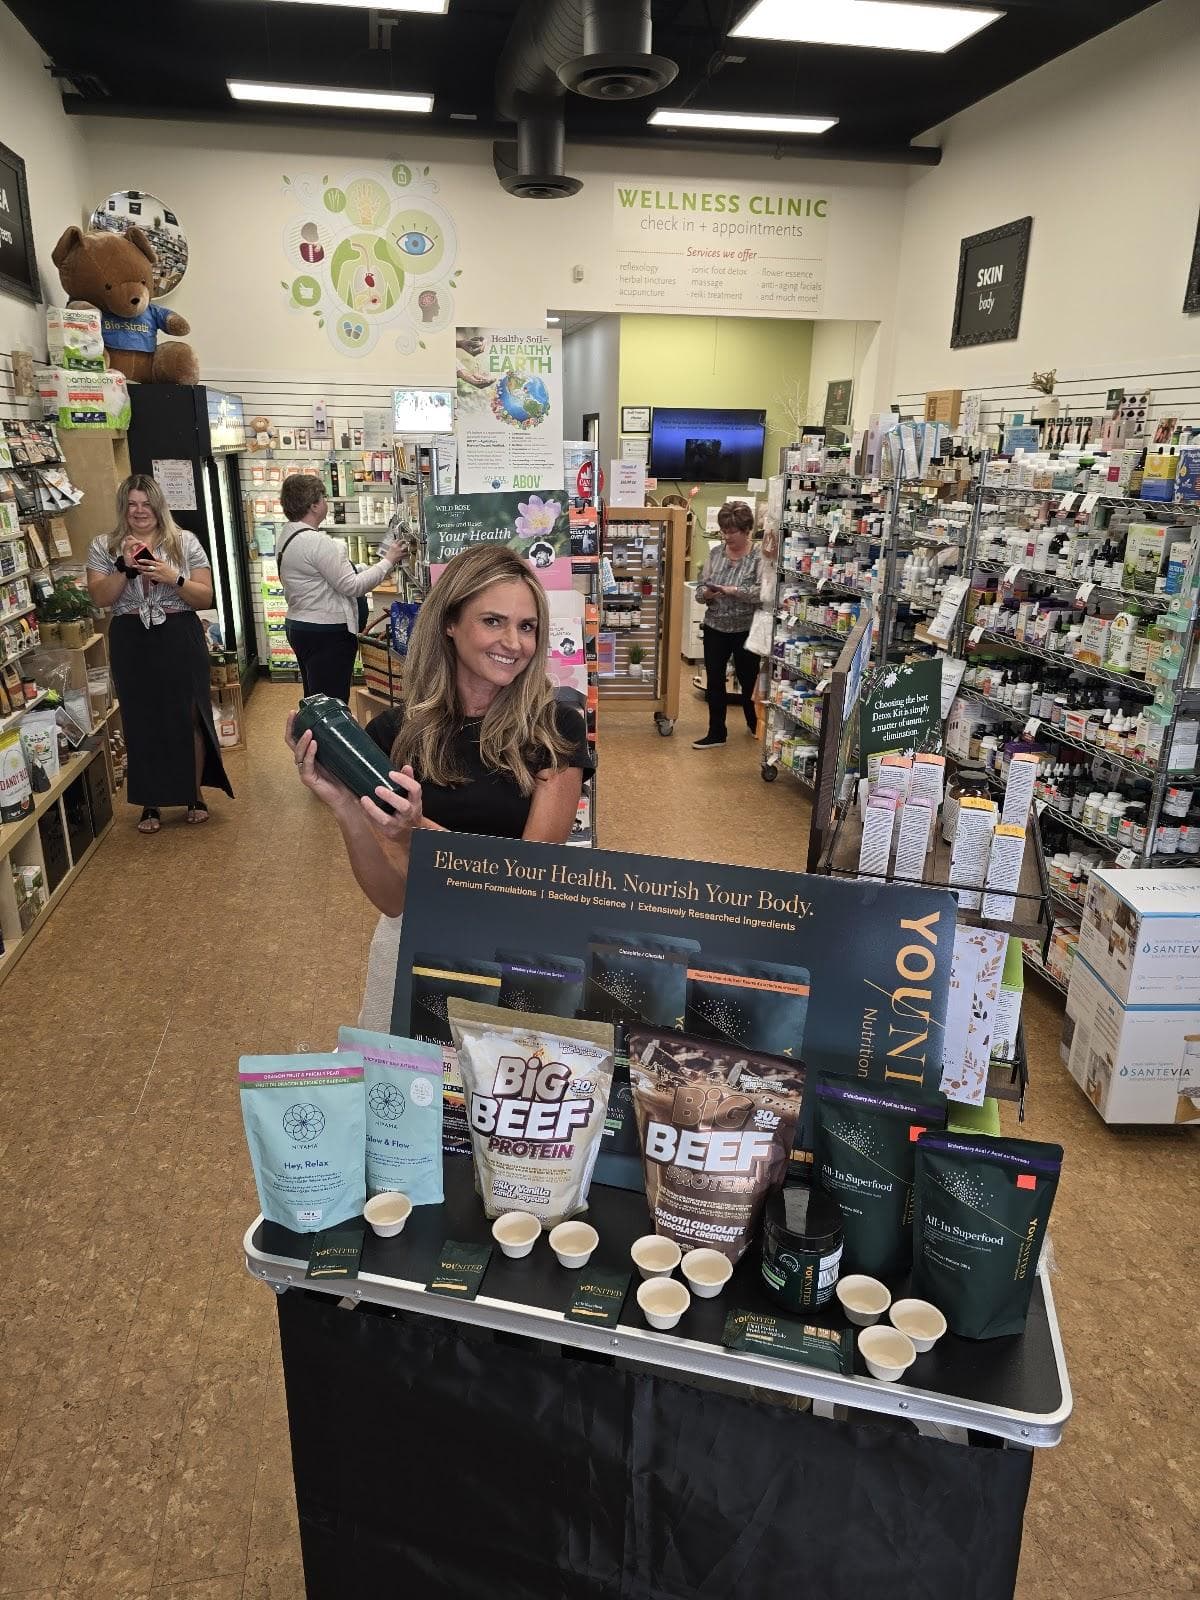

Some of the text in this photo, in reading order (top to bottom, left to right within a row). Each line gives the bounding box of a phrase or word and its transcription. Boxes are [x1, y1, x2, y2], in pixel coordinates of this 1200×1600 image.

[618, 188, 828, 218] WELLNESS CLINIC
[640, 215, 677, 232] check
[682, 218, 695, 232] in
[712, 221, 803, 238] appointments
[686, 246, 758, 262] Services we offer
[619, 261, 659, 273] reflexology
[761, 268, 813, 279] flower essence
[619, 275, 642, 284] herbal
[691, 279, 723, 288] massage
[976, 264, 1003, 287] SKIN
[619, 288, 665, 298] acupuncture
[761, 281, 822, 292] anti-aging facials
[708, 291, 743, 301] treatment
[760, 293, 774, 301] and
[775, 294, 796, 302] much
[978, 291, 995, 315] body
[491, 334, 524, 345] Healthy
[489, 344, 552, 356] A HEALTHY
[489, 355, 552, 374] EARTH
[512, 474, 541, 489] ABOV
[439, 528, 511, 543] Your Health
[875, 693, 928, 710] Choosing the best
[872, 713, 891, 721] Detox
[893, 707, 903, 718] Kit
[910, 703, 929, 716] simply
[877, 722, 898, 732] matter
[899, 717, 906, 728] of
[433, 850, 814, 919] Elevate Your Health. Nourish Your Body.
[446, 877, 483, 890] Premium
[484, 883, 537, 897] Formulations
[548, 890, 578, 903] Backed
[581, 894, 591, 906] by
[593, 896, 626, 909] Science
[638, 903, 687, 919] Extensively
[688, 909, 741, 925] Researched
[743, 916, 796, 932] Ingredients
[857, 1007, 878, 1079] Nutrition
[1131, 1068, 1191, 1077] SANTEVIA
[471, 1092, 594, 1143] BEEF
[384, 1138, 390, 1146] &
[392, 1140, 410, 1149] Flow
[488, 1136, 577, 1161] PROTEIN
[646, 1121, 774, 1172] BEEF
[284, 1160, 329, 1171] Hey, Relax
[666, 1166, 758, 1194] PROTEIN
[822, 1164, 893, 1192] All-In Superfood
[518, 1184, 551, 1197] Vanilla
[655, 1207, 746, 1236] SMOOTH CHOCOLATE
[657, 1217, 696, 1236] CHOCOLAT
[925, 1214, 1004, 1246] All-In Superfood
[441, 1262, 483, 1270] YOUNITED
[803, 1265, 814, 1305] YOUNITED
[734, 1314, 776, 1326] YOUNITED
